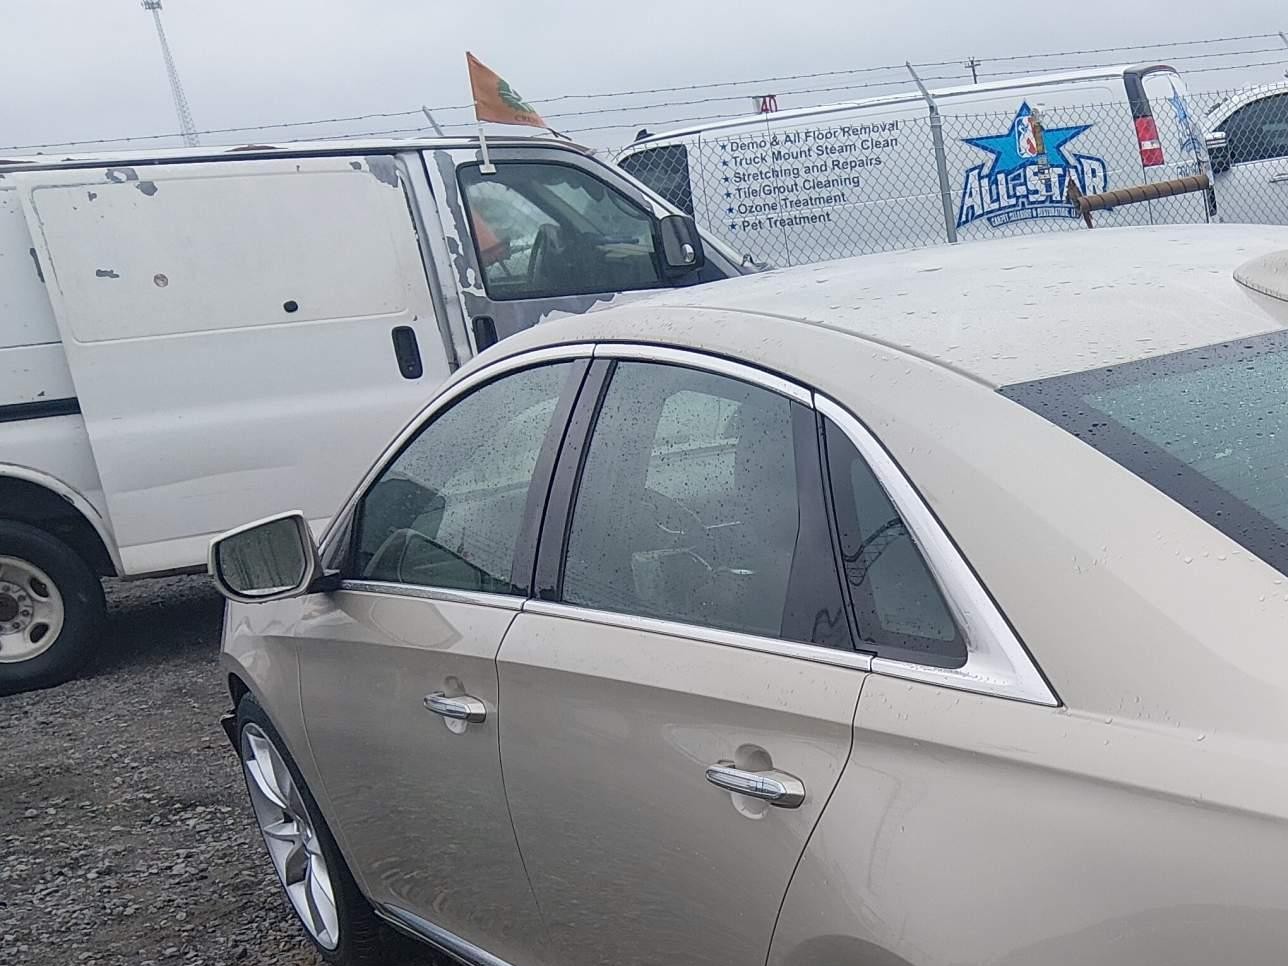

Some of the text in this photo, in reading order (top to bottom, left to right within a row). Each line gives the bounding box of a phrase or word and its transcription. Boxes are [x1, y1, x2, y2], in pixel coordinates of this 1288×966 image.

[730, 119, 900, 152] Demo & All Floor Removal
[732, 137, 898, 168] Truck Mount Steam Clean
[733, 156, 882, 184] Stretching and Repairs
[735, 174, 860, 200] Tile/Grout Cleaning
[957, 154, 1107, 227] ALL-STAR
[737, 192, 847, 215] Ozone Treatment
[742, 211, 832, 232] Pet Treatment
